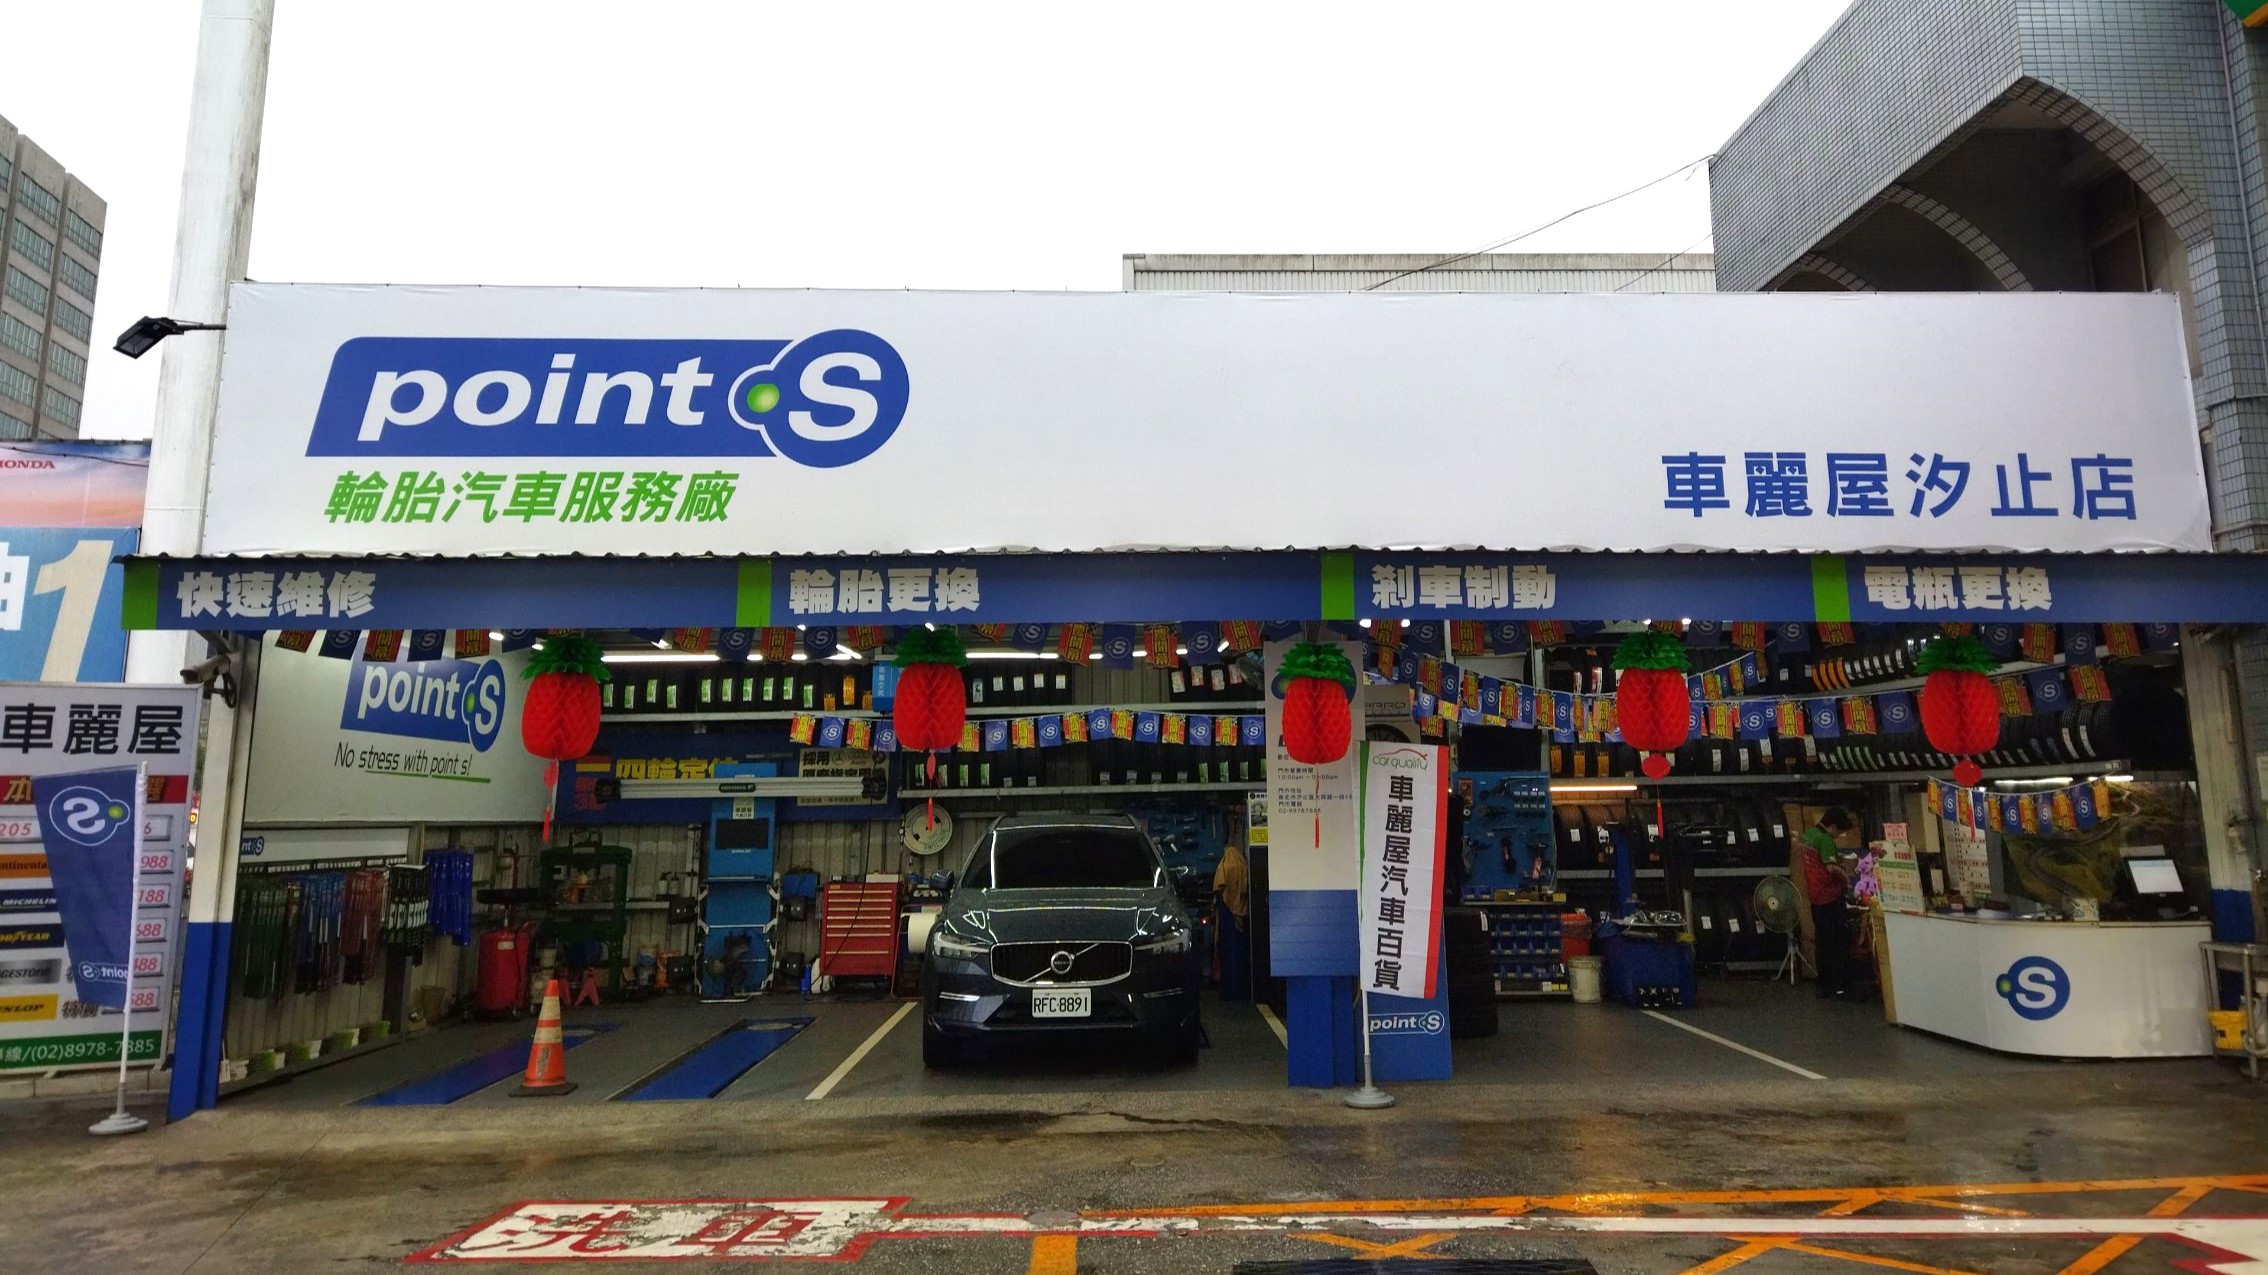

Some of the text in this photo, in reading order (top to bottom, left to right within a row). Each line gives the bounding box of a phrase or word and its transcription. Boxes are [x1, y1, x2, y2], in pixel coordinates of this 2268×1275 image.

[358, 351, 882, 442] point S
[324, 471, 739, 524] 輪胎汽車服務廠
[1661, 451, 2138, 521] 車麗屋汐止店
[177, 571, 377, 618] 快速維修
[788, 565, 982, 615] 輪胎更換
[1370, 563, 1558, 611] 剎車制動
[1864, 564, 2054, 611] 電瓶更換
[357, 661, 501, 736] point S
[0, 703, 184, 755] 車麗屋
[334, 741, 354, 769] No
[358, 745, 400, 772] stress
[403, 748, 429, 774] with
[429, 753, 459, 775] point
[2, 897, 57, 906] MICHELIN
[1373, 775, 1415, 991] 車麗屋汽車百貨
[1369, 1015, 1417, 1031] point
